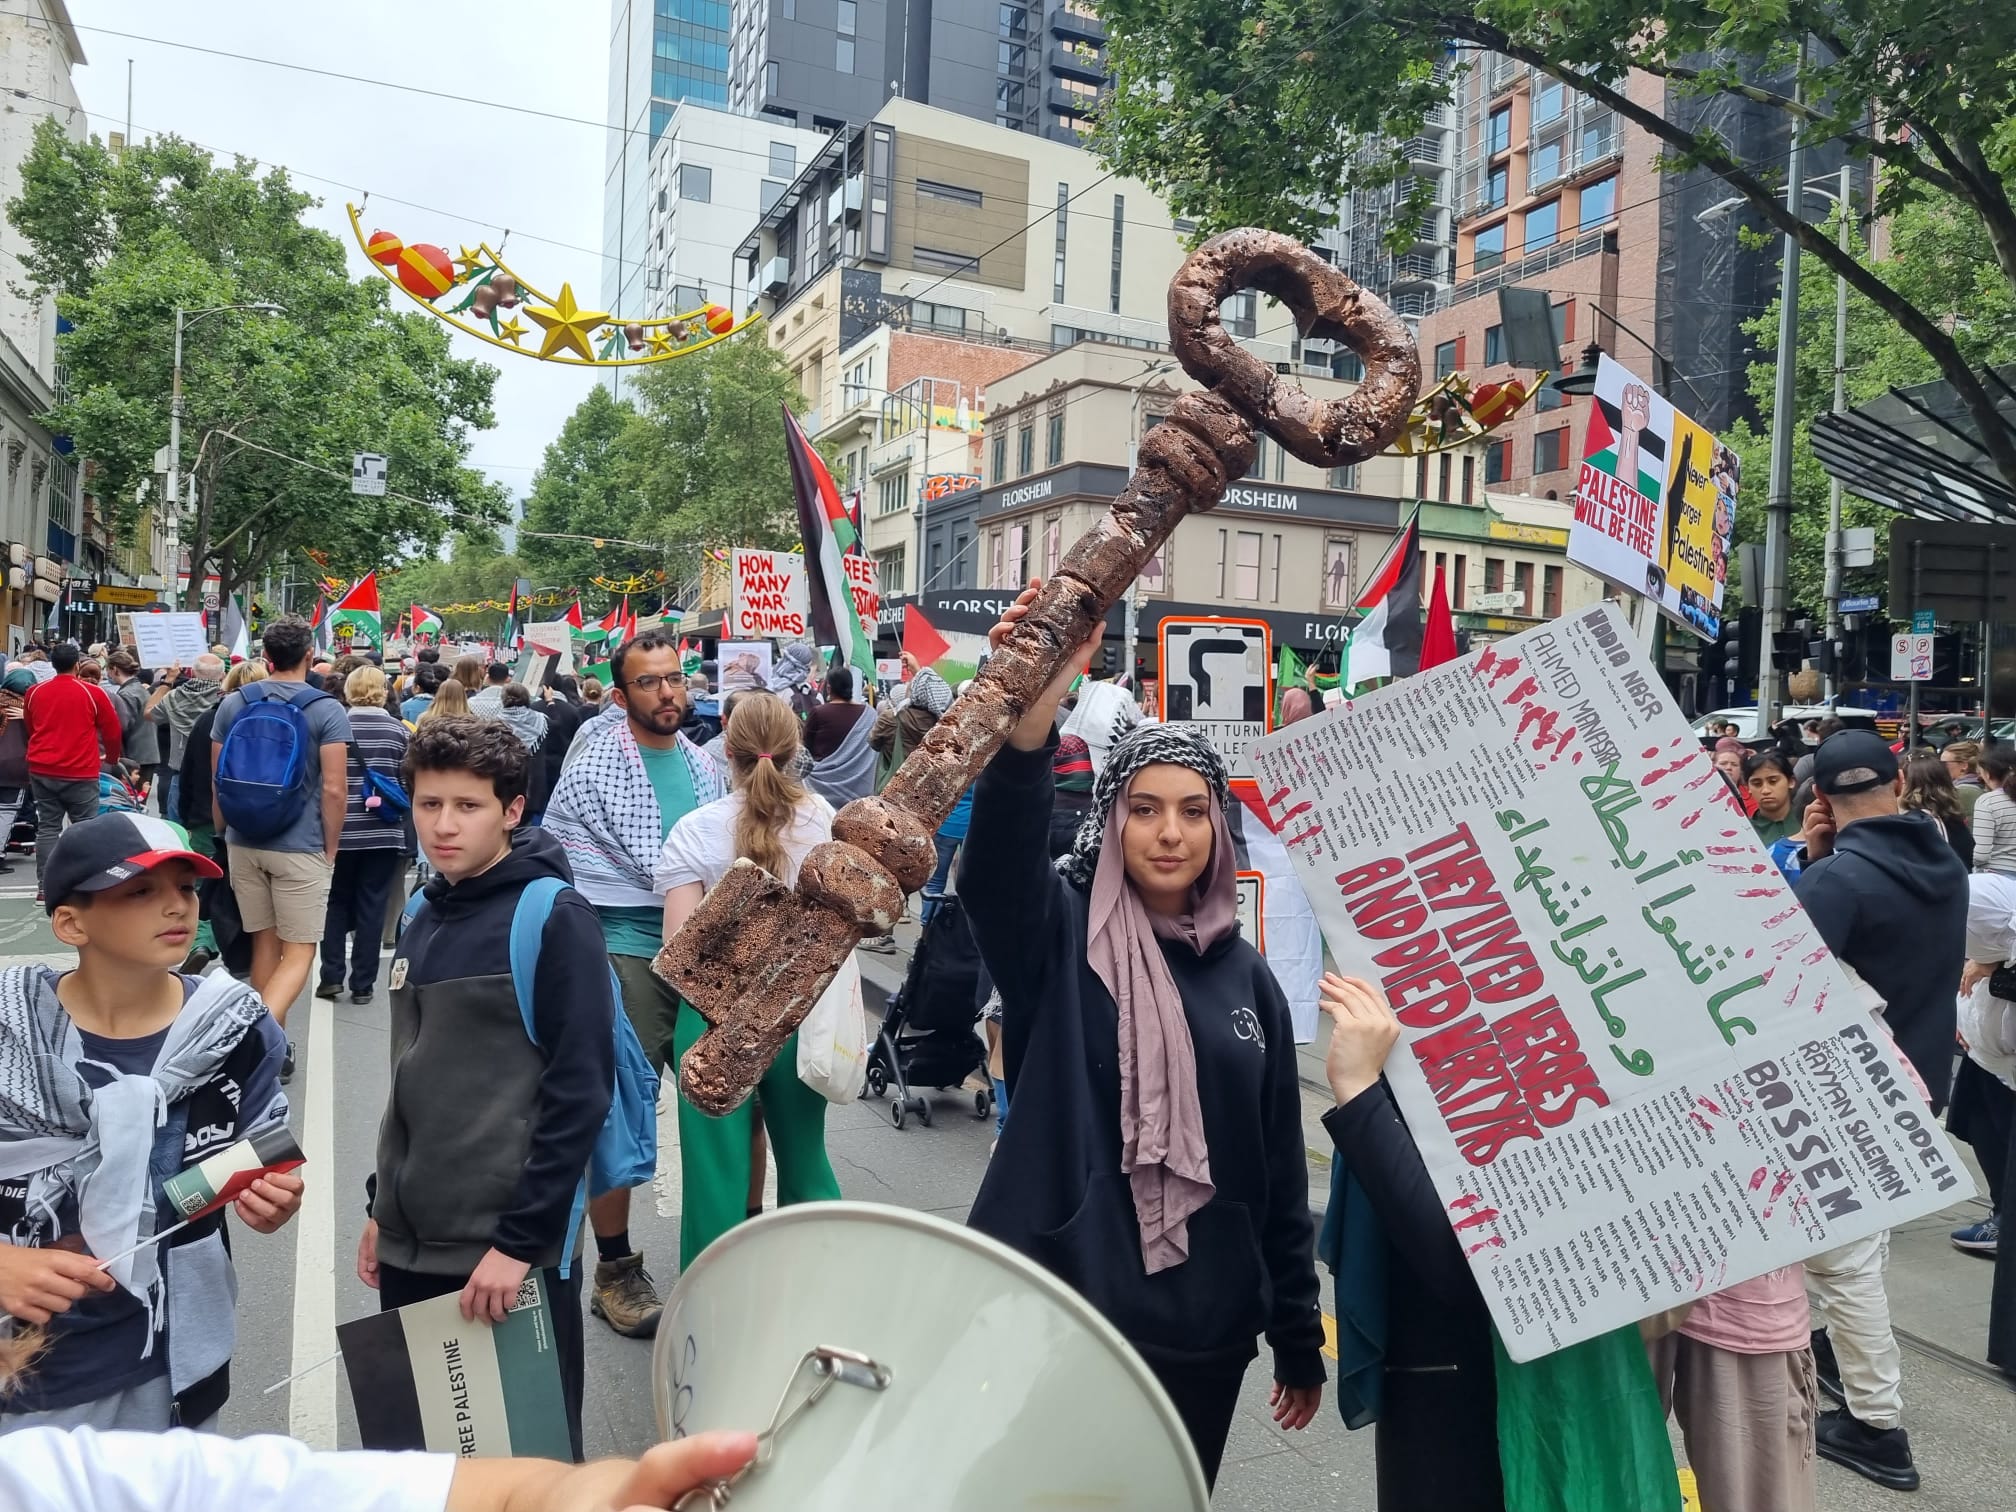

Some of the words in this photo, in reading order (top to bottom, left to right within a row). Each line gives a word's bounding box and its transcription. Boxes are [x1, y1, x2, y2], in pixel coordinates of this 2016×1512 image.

[1002, 480, 1052, 508] FLORSHEIM
[1577, 463, 1658, 534] PALESTINE
[1686, 459, 1708, 492] Never
[1574, 495, 1605, 534] WILL
[1608, 514, 1626, 544] BE
[1627, 523, 1655, 560] FREE
[1672, 526, 1715, 581] Palestine
[739, 554, 774, 577] HOW
[743, 574, 791, 593] MANY
[741, 610, 804, 635] CRIMES
[1440, 673, 1455, 690] AYA
[1452, 691, 1475, 728] MAHMOUD
[1442, 699, 1459, 726] SHADI
[1527, 630, 1581, 699] AHMED
[1565, 697, 1622, 766] MANASRA
[1619, 668, 1663, 722] NASR
[1224, 724, 1261, 737] TURN
[1406, 821, 1503, 911] THEY
[1335, 856, 1429, 940] AND
[1372, 929, 1472, 1029] DIED
[1442, 902, 1545, 1004] LIVED
[1490, 995, 1610, 1127] HEROES
[1836, 1057, 1864, 1094] throwing
[1410, 1014, 1543, 1167] MARTYRS
[1726, 1072, 1750, 1100] Killed
[1754, 1114, 1776, 1144] Israeli
[1837, 1022, 1908, 1108] FARIS
[1893, 1109, 1958, 1192] ODEH
[1741, 1058, 1863, 1222] BASSEM
[1797, 1039, 1858, 1120] RAYYAN
[1843, 1118, 1911, 1202] SULEIMAN
[4, 1185, 27, 1199] DIE
[1709, 1169, 1727, 1197] SIHAM
[1579, 1229, 1595, 1253] JUDY
[1590, 1255, 1608, 1283] MUSA
[1720, 1217, 1736, 1241] RAMI
[1566, 1237, 1586, 1271] KENAN
[1583, 1274, 1599, 1298] IYAD
[1651, 1241, 1682, 1293] MUHAMMAD
[1551, 1277, 1578, 1324] MUHAMMAD
[443, 1338, 472, 1422] PALESTINE
[458, 1424, 477, 1459] REE
